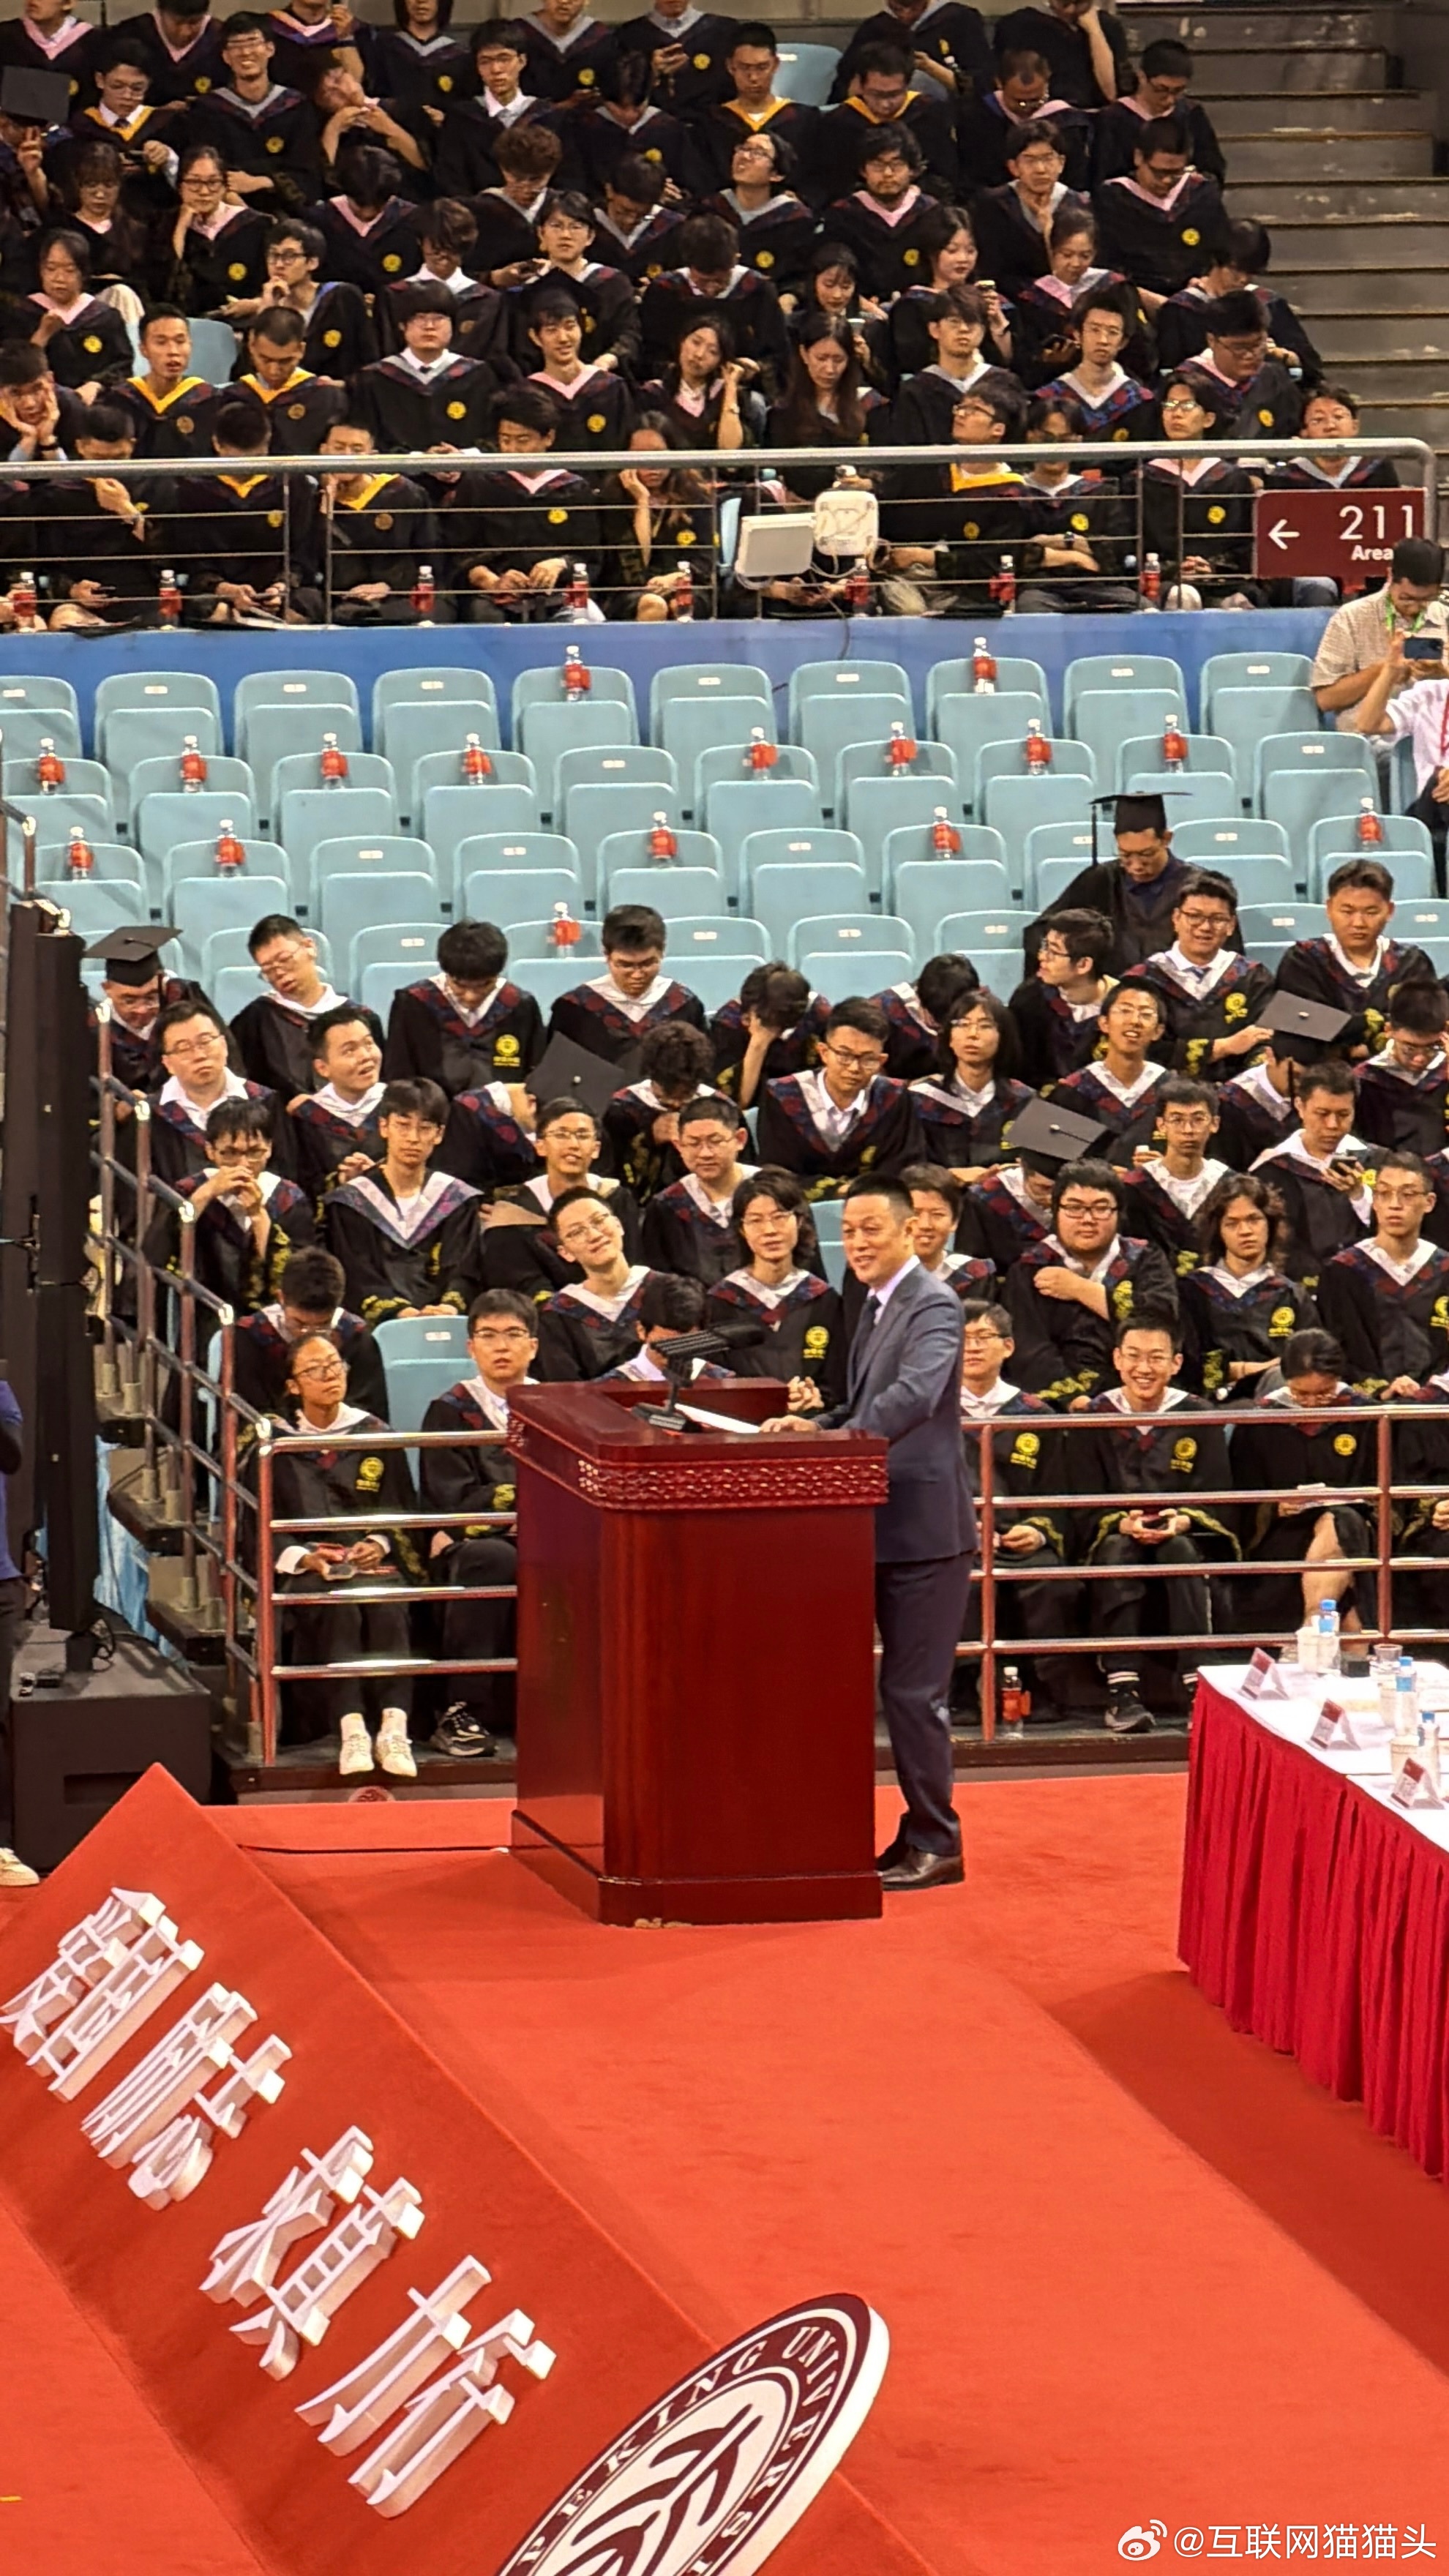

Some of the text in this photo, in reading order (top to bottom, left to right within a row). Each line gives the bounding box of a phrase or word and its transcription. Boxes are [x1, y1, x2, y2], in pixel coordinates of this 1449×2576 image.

[1339, 505, 1413, 540] 211
[1351, 544, 1394, 561] Area
[0, 1887, 558, 2520] 爱国 励志 求真 力行
[519, 2340, 767, 2566] PEKING
